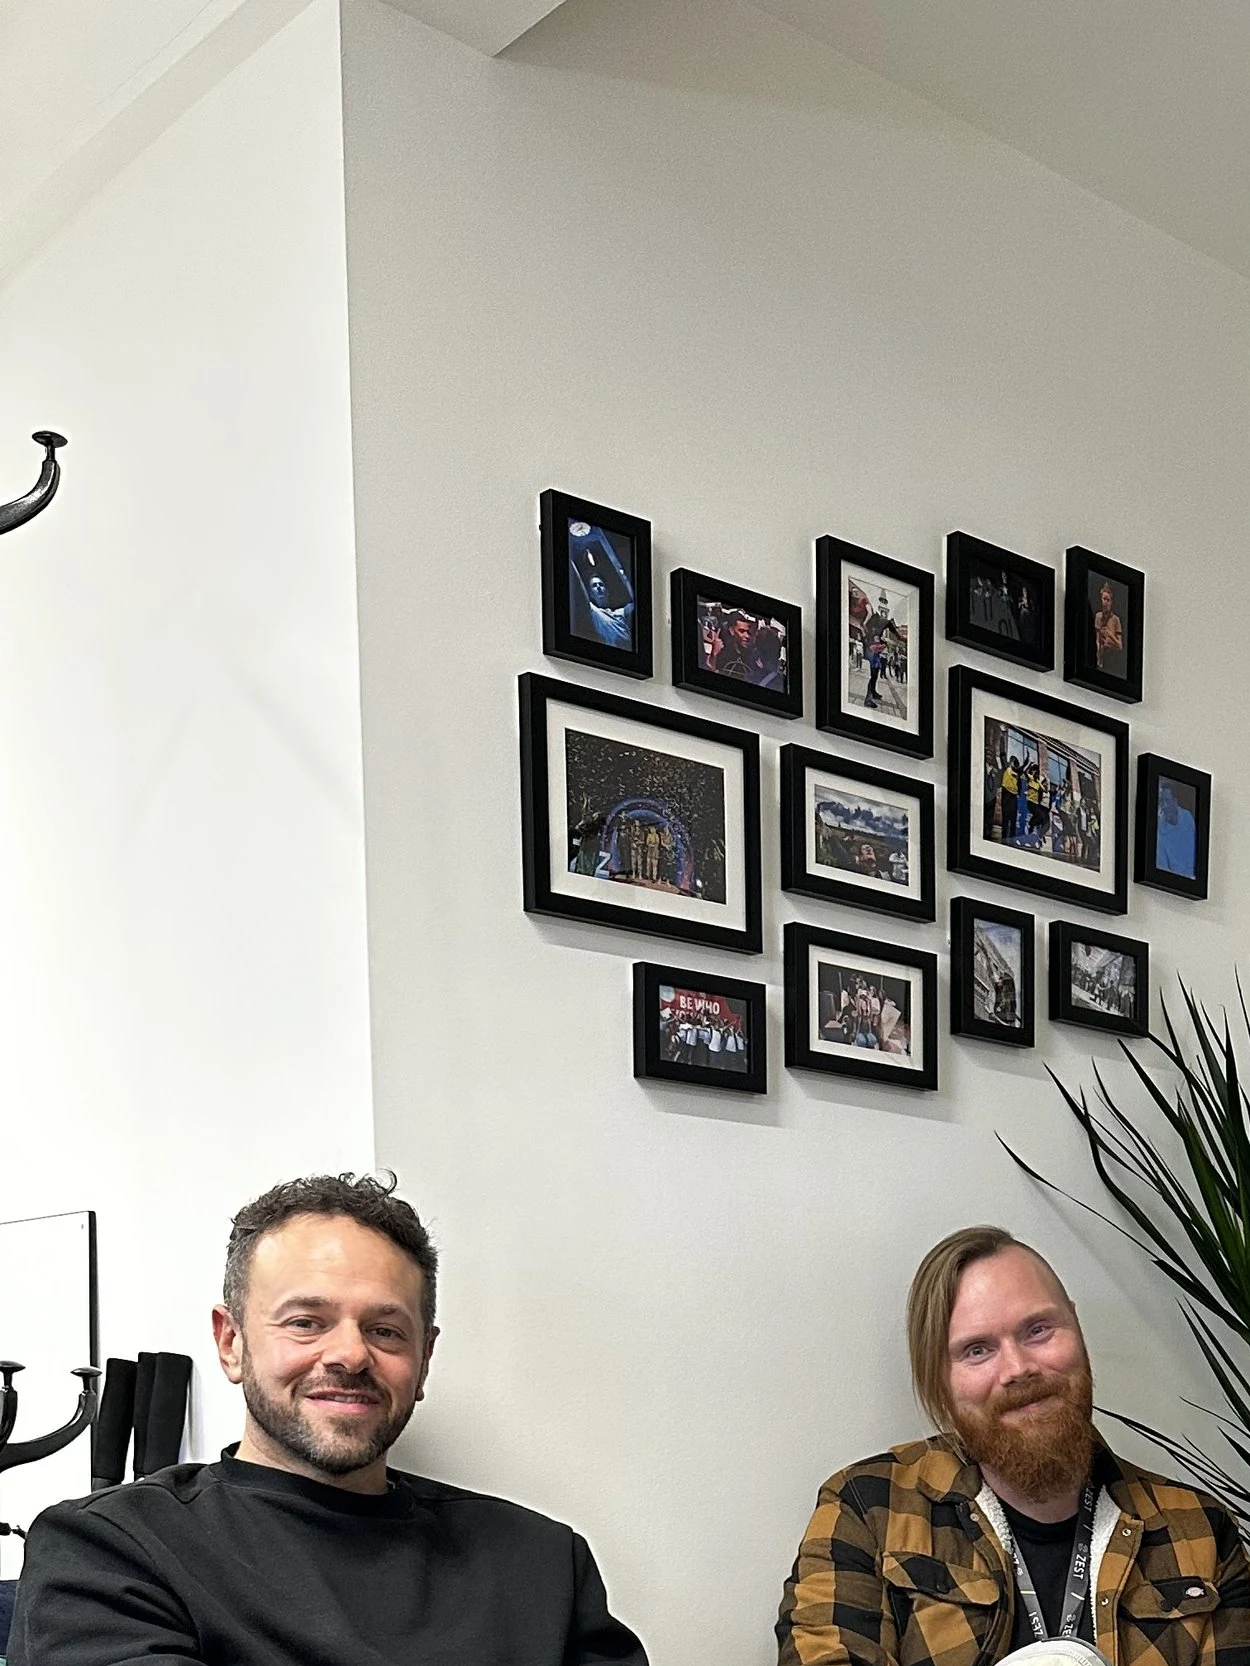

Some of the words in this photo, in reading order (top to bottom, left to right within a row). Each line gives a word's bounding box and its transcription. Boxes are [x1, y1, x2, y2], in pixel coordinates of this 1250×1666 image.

[679, 995, 693, 1010] BE
[1083, 1486, 1094, 1513] ZEST
[1073, 1554, 1087, 1580] ZEST
